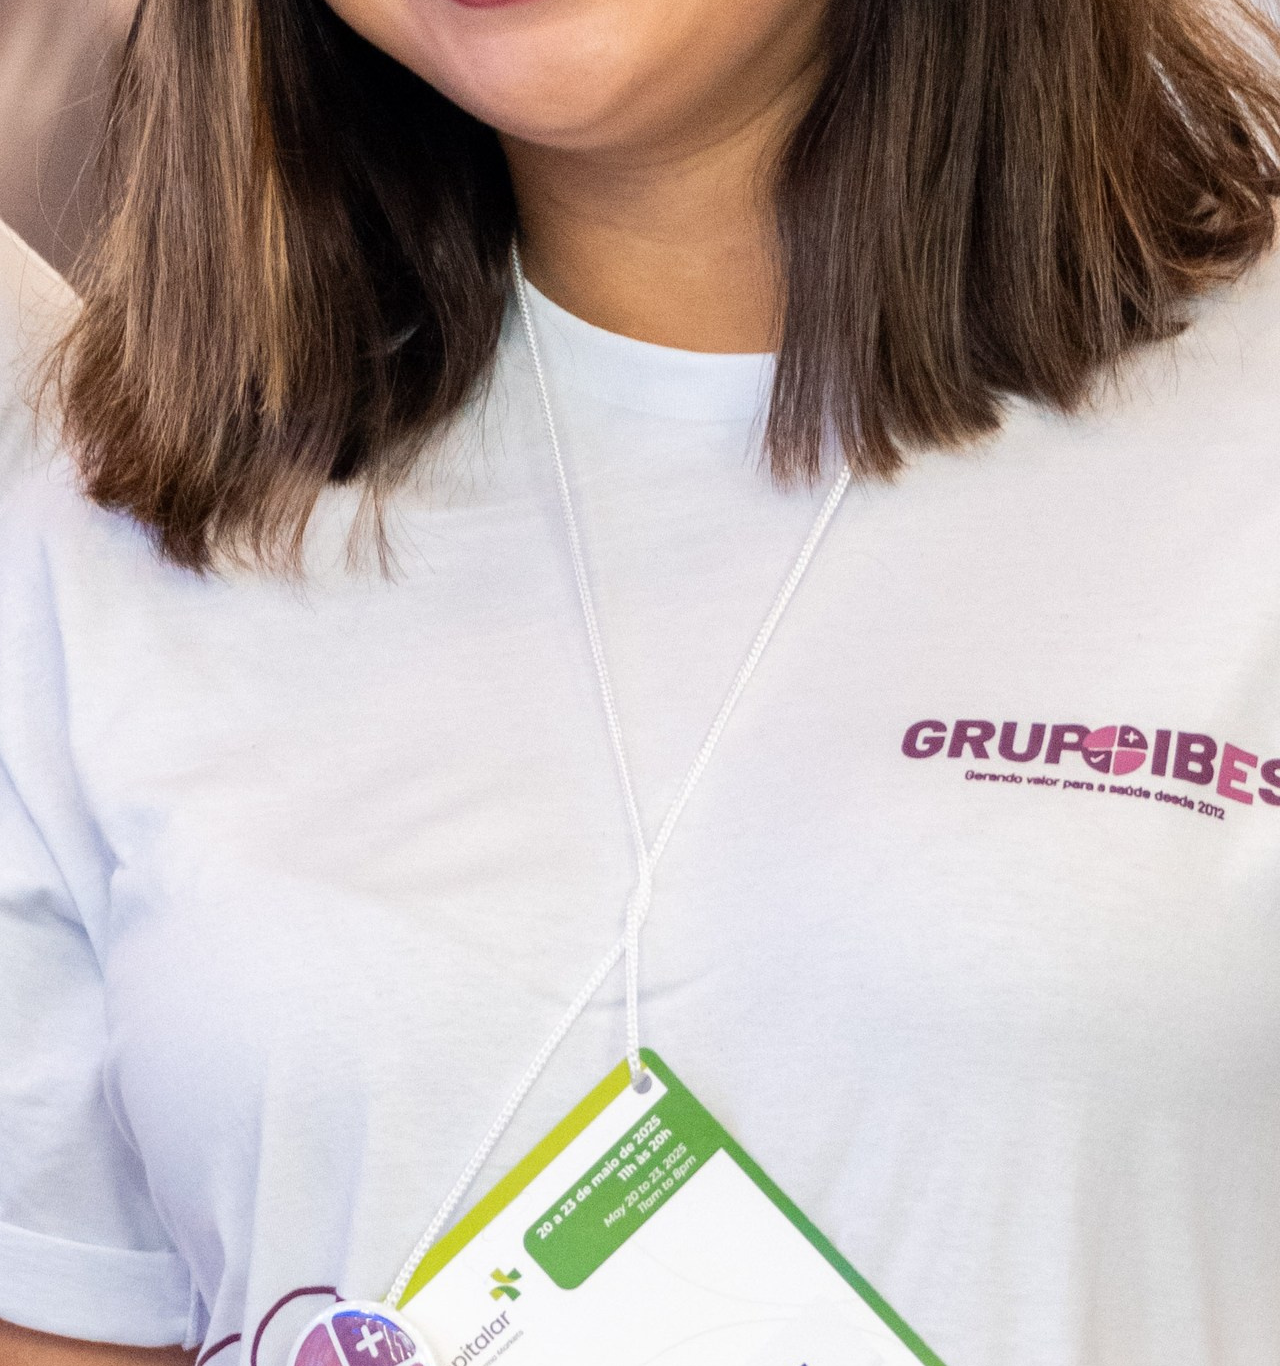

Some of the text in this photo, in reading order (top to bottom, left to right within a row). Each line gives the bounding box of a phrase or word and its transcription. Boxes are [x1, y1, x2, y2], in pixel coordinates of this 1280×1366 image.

[964, 769, 1226, 821] Gerando valor para a saúde desde 2012
[536, 1115, 663, 1240] 20 a 23 de maio de 2025
[603, 1204, 627, 1228] May
[624, 1190, 641, 1208] 20
[638, 1180, 650, 1195] to
[662, 1142, 688, 1169] 2025
[617, 1127, 673, 1183] 11h às 20h
[637, 1154, 698, 1215] 11am to 8pm
